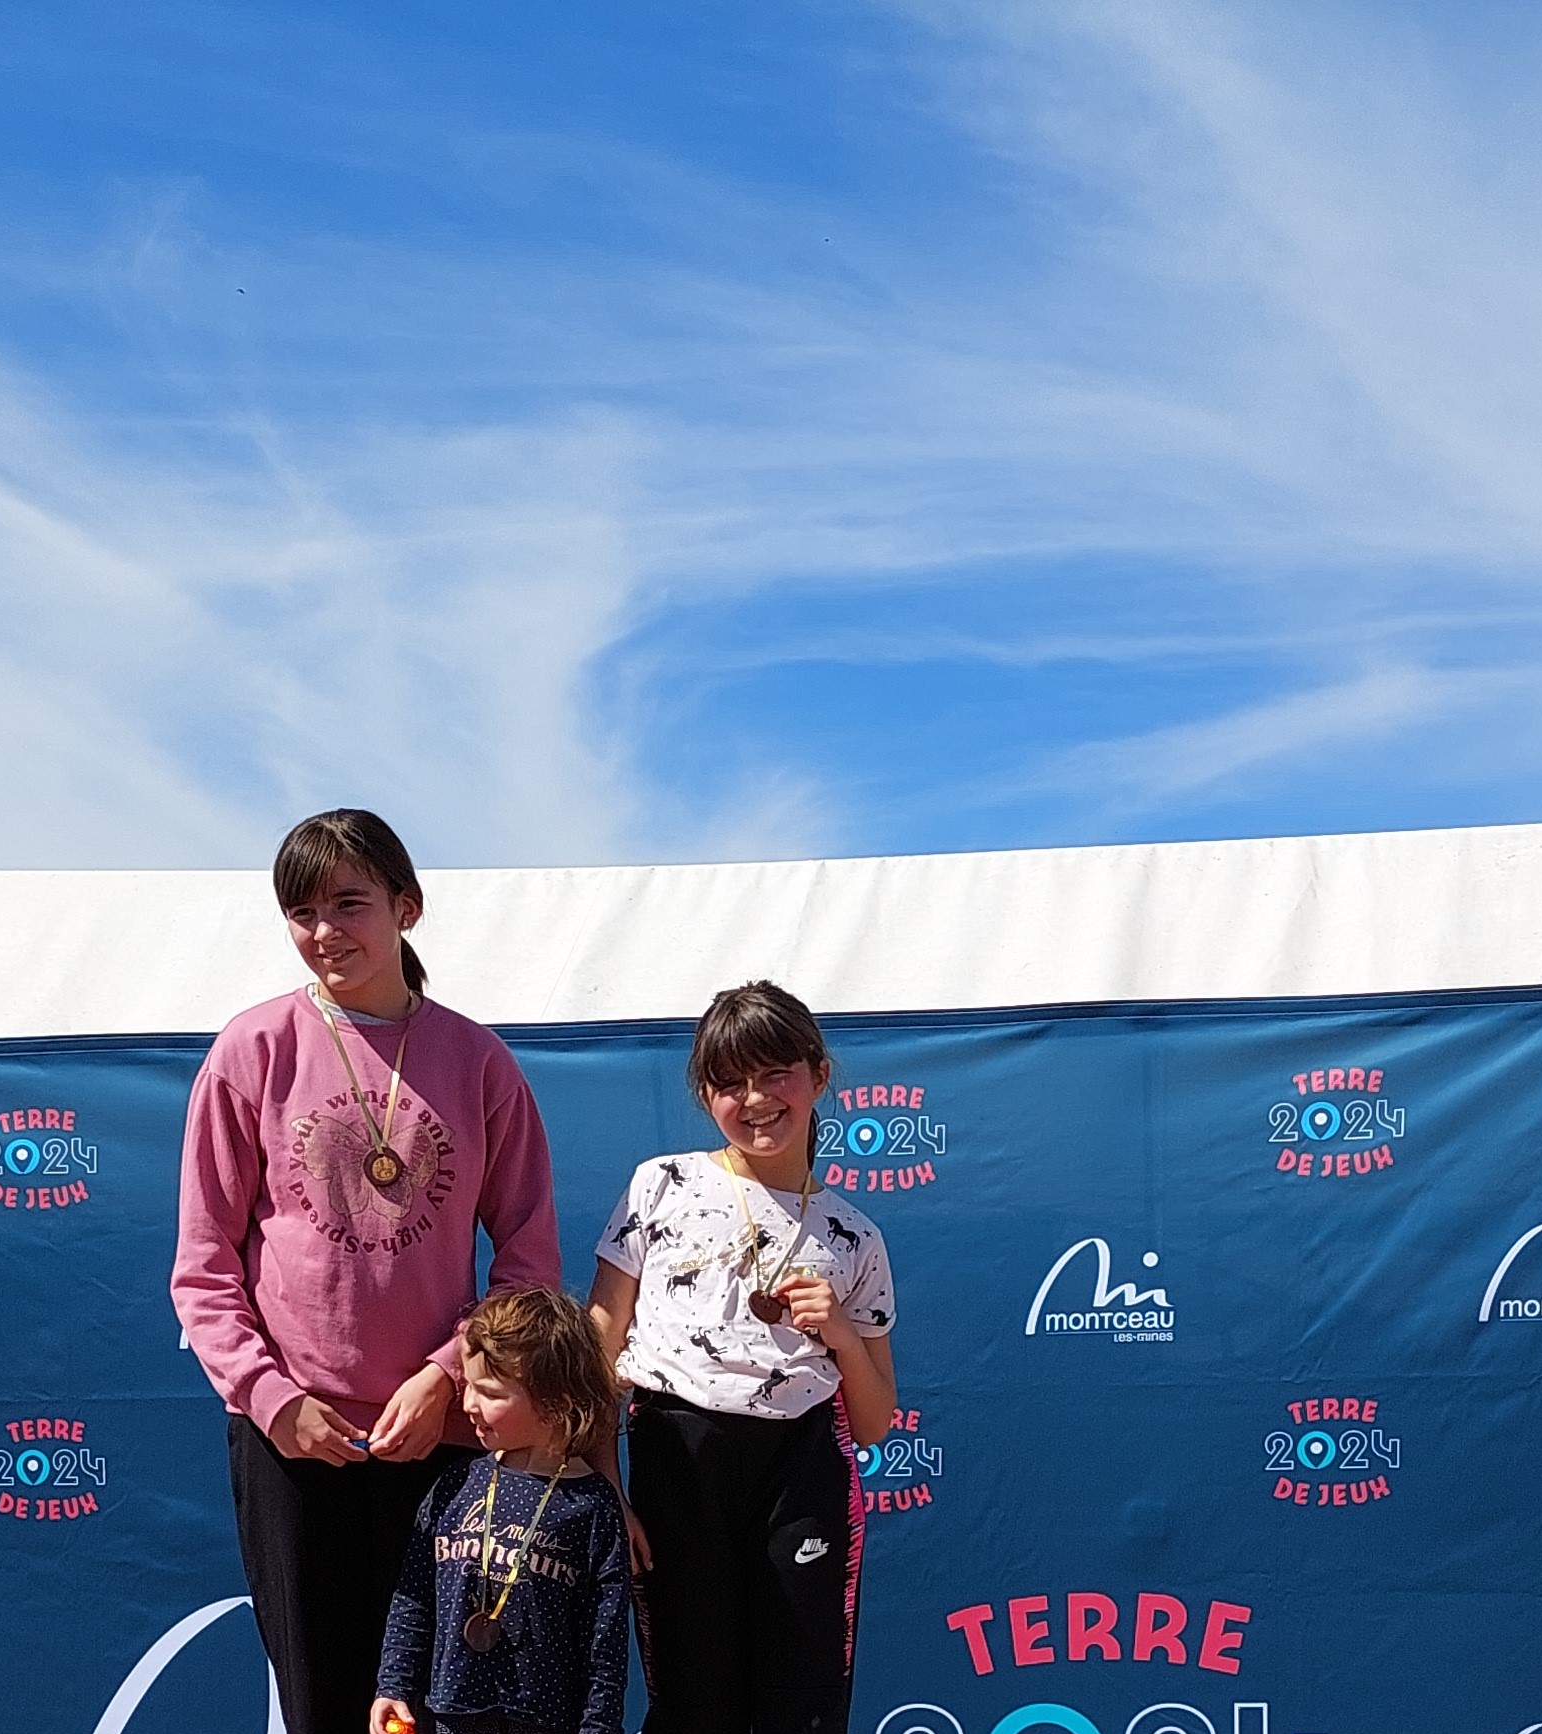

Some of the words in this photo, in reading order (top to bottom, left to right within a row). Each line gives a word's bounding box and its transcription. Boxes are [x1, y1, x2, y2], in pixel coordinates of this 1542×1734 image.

[1293, 1067, 1384, 1096] TERRE
[838, 1085, 924, 1112] TERRE
[418, 1109, 455, 1157] and
[816, 1115, 946, 1157] 2024
[1268, 1099, 1405, 1143] 2024
[289, 1110, 321, 1172] your
[824, 1163, 859, 1191] DE
[867, 1160, 936, 1192] JEUX
[1276, 1148, 1314, 1177] DE
[1321, 1144, 1393, 1178] JEUX
[25, 1180, 89, 1209] JEUX
[426, 1170, 456, 1210] fly
[381, 1214, 433, 1256] high
[1288, 1397, 1379, 1425] TERRE
[6, 1418, 84, 1443] TERRE
[1264, 1429, 1401, 1472] 2024
[35, 1491, 99, 1521] JEUX
[864, 1482, 932, 1514] JEUX
[1274, 1476, 1310, 1505] DE
[1318, 1475, 1391, 1507] JEUX
[947, 1592, 1252, 1677] TERRE
